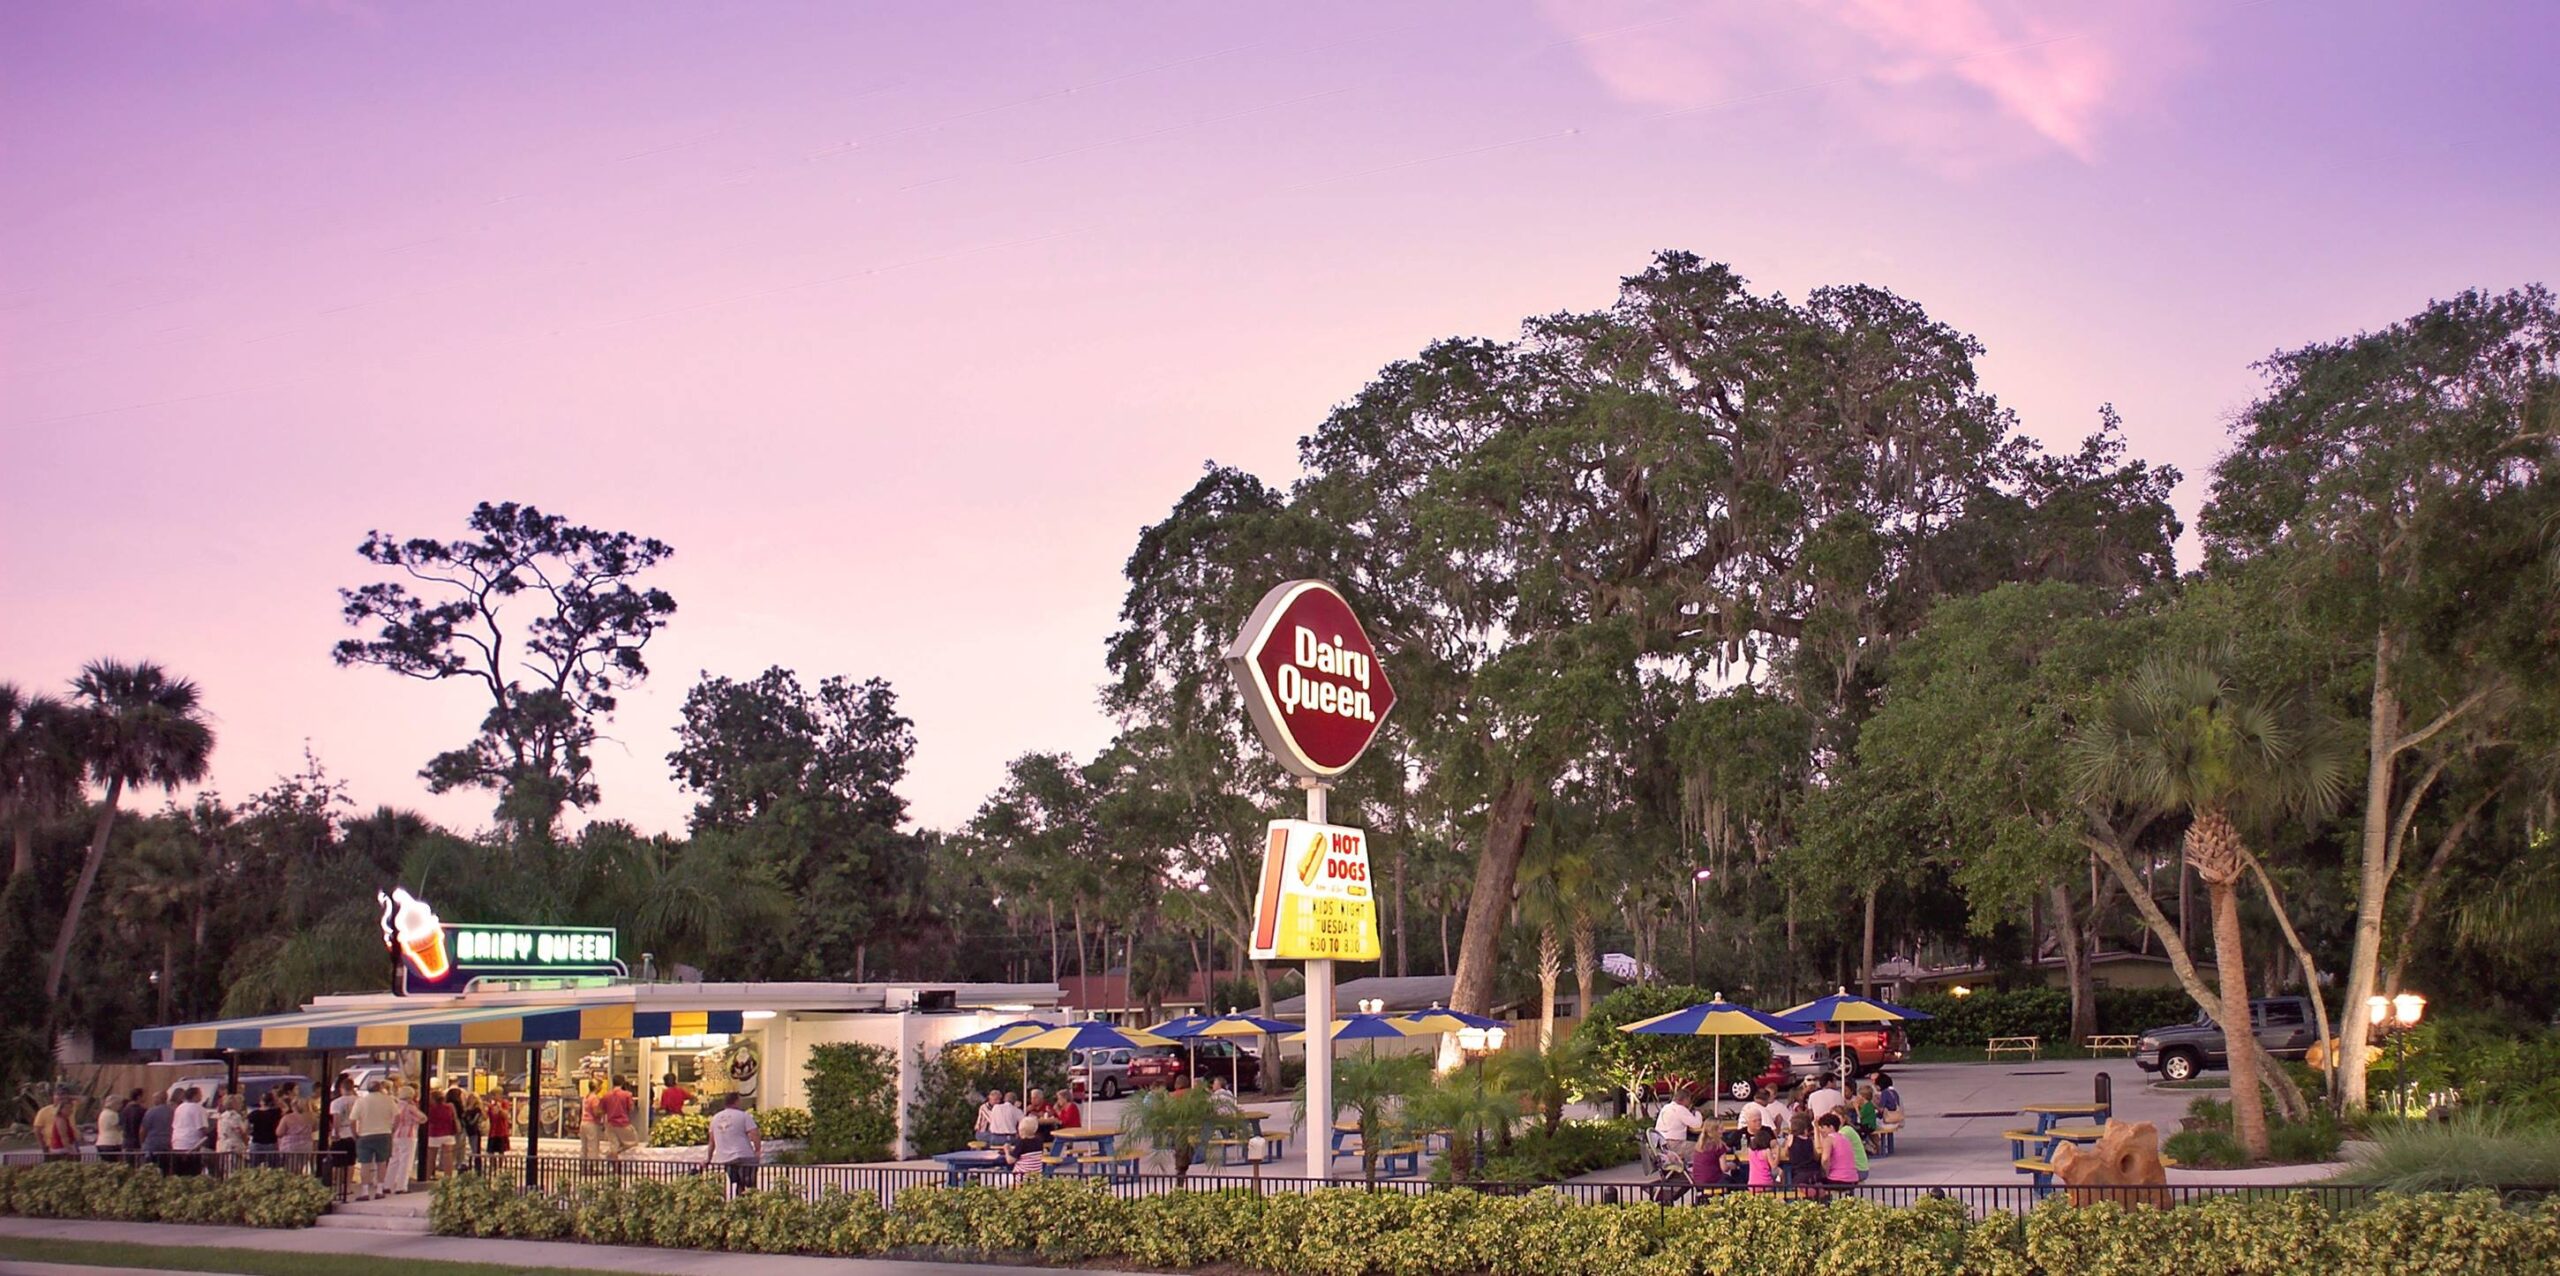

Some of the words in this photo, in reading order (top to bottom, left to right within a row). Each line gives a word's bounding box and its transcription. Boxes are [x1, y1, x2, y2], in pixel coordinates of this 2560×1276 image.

[1295, 625, 1370, 690] Dairy
[1332, 833, 1360, 855] HOT
[1328, 859, 1365, 881] DOGS
[1312, 899, 1334, 915] KIDS
[1341, 903, 1365, 918] NIGHT
[456, 931, 532, 960] DAIRY
[537, 933, 611, 963] QUEEN
[1329, 938, 1339, 953] TO
